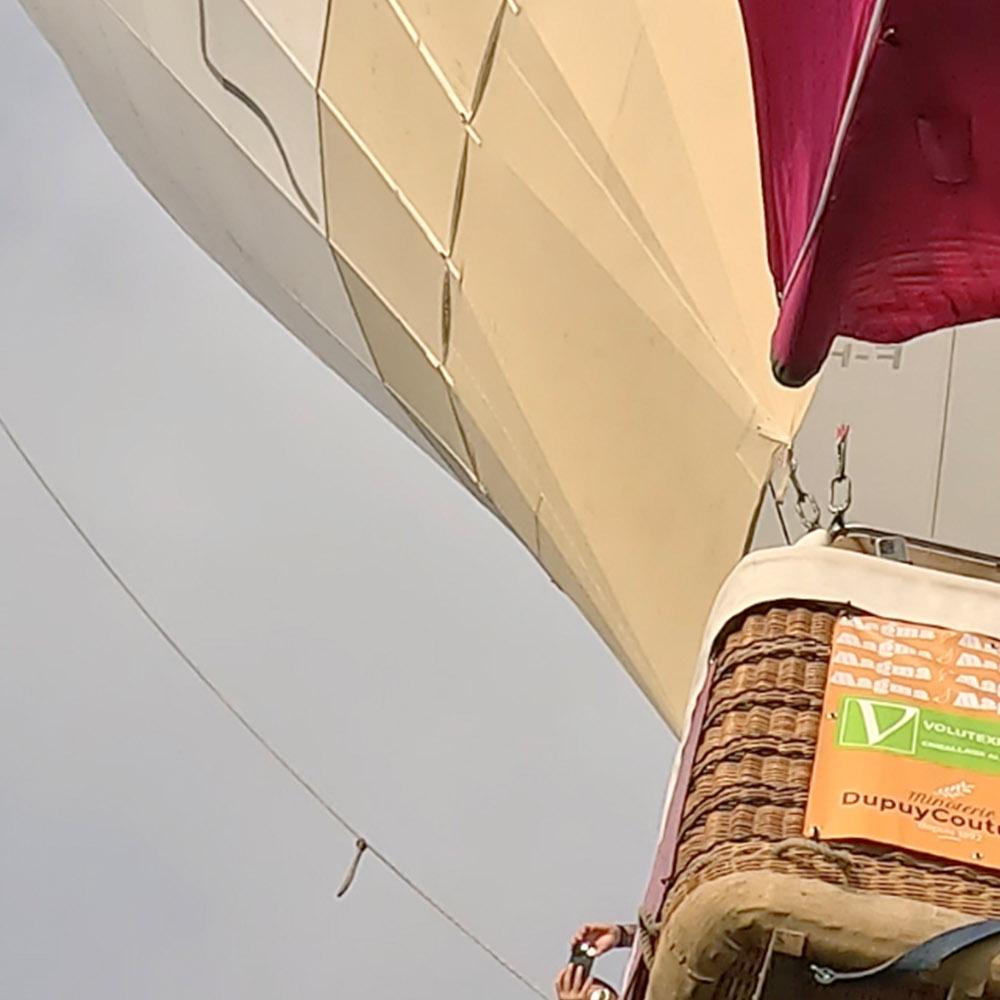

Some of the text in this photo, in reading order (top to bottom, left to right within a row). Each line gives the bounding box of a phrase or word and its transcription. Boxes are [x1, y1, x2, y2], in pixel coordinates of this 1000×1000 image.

[836, 633, 933, 660] Magma
[833, 651, 932, 680] Magma
[831, 671, 930, 701] Magma
